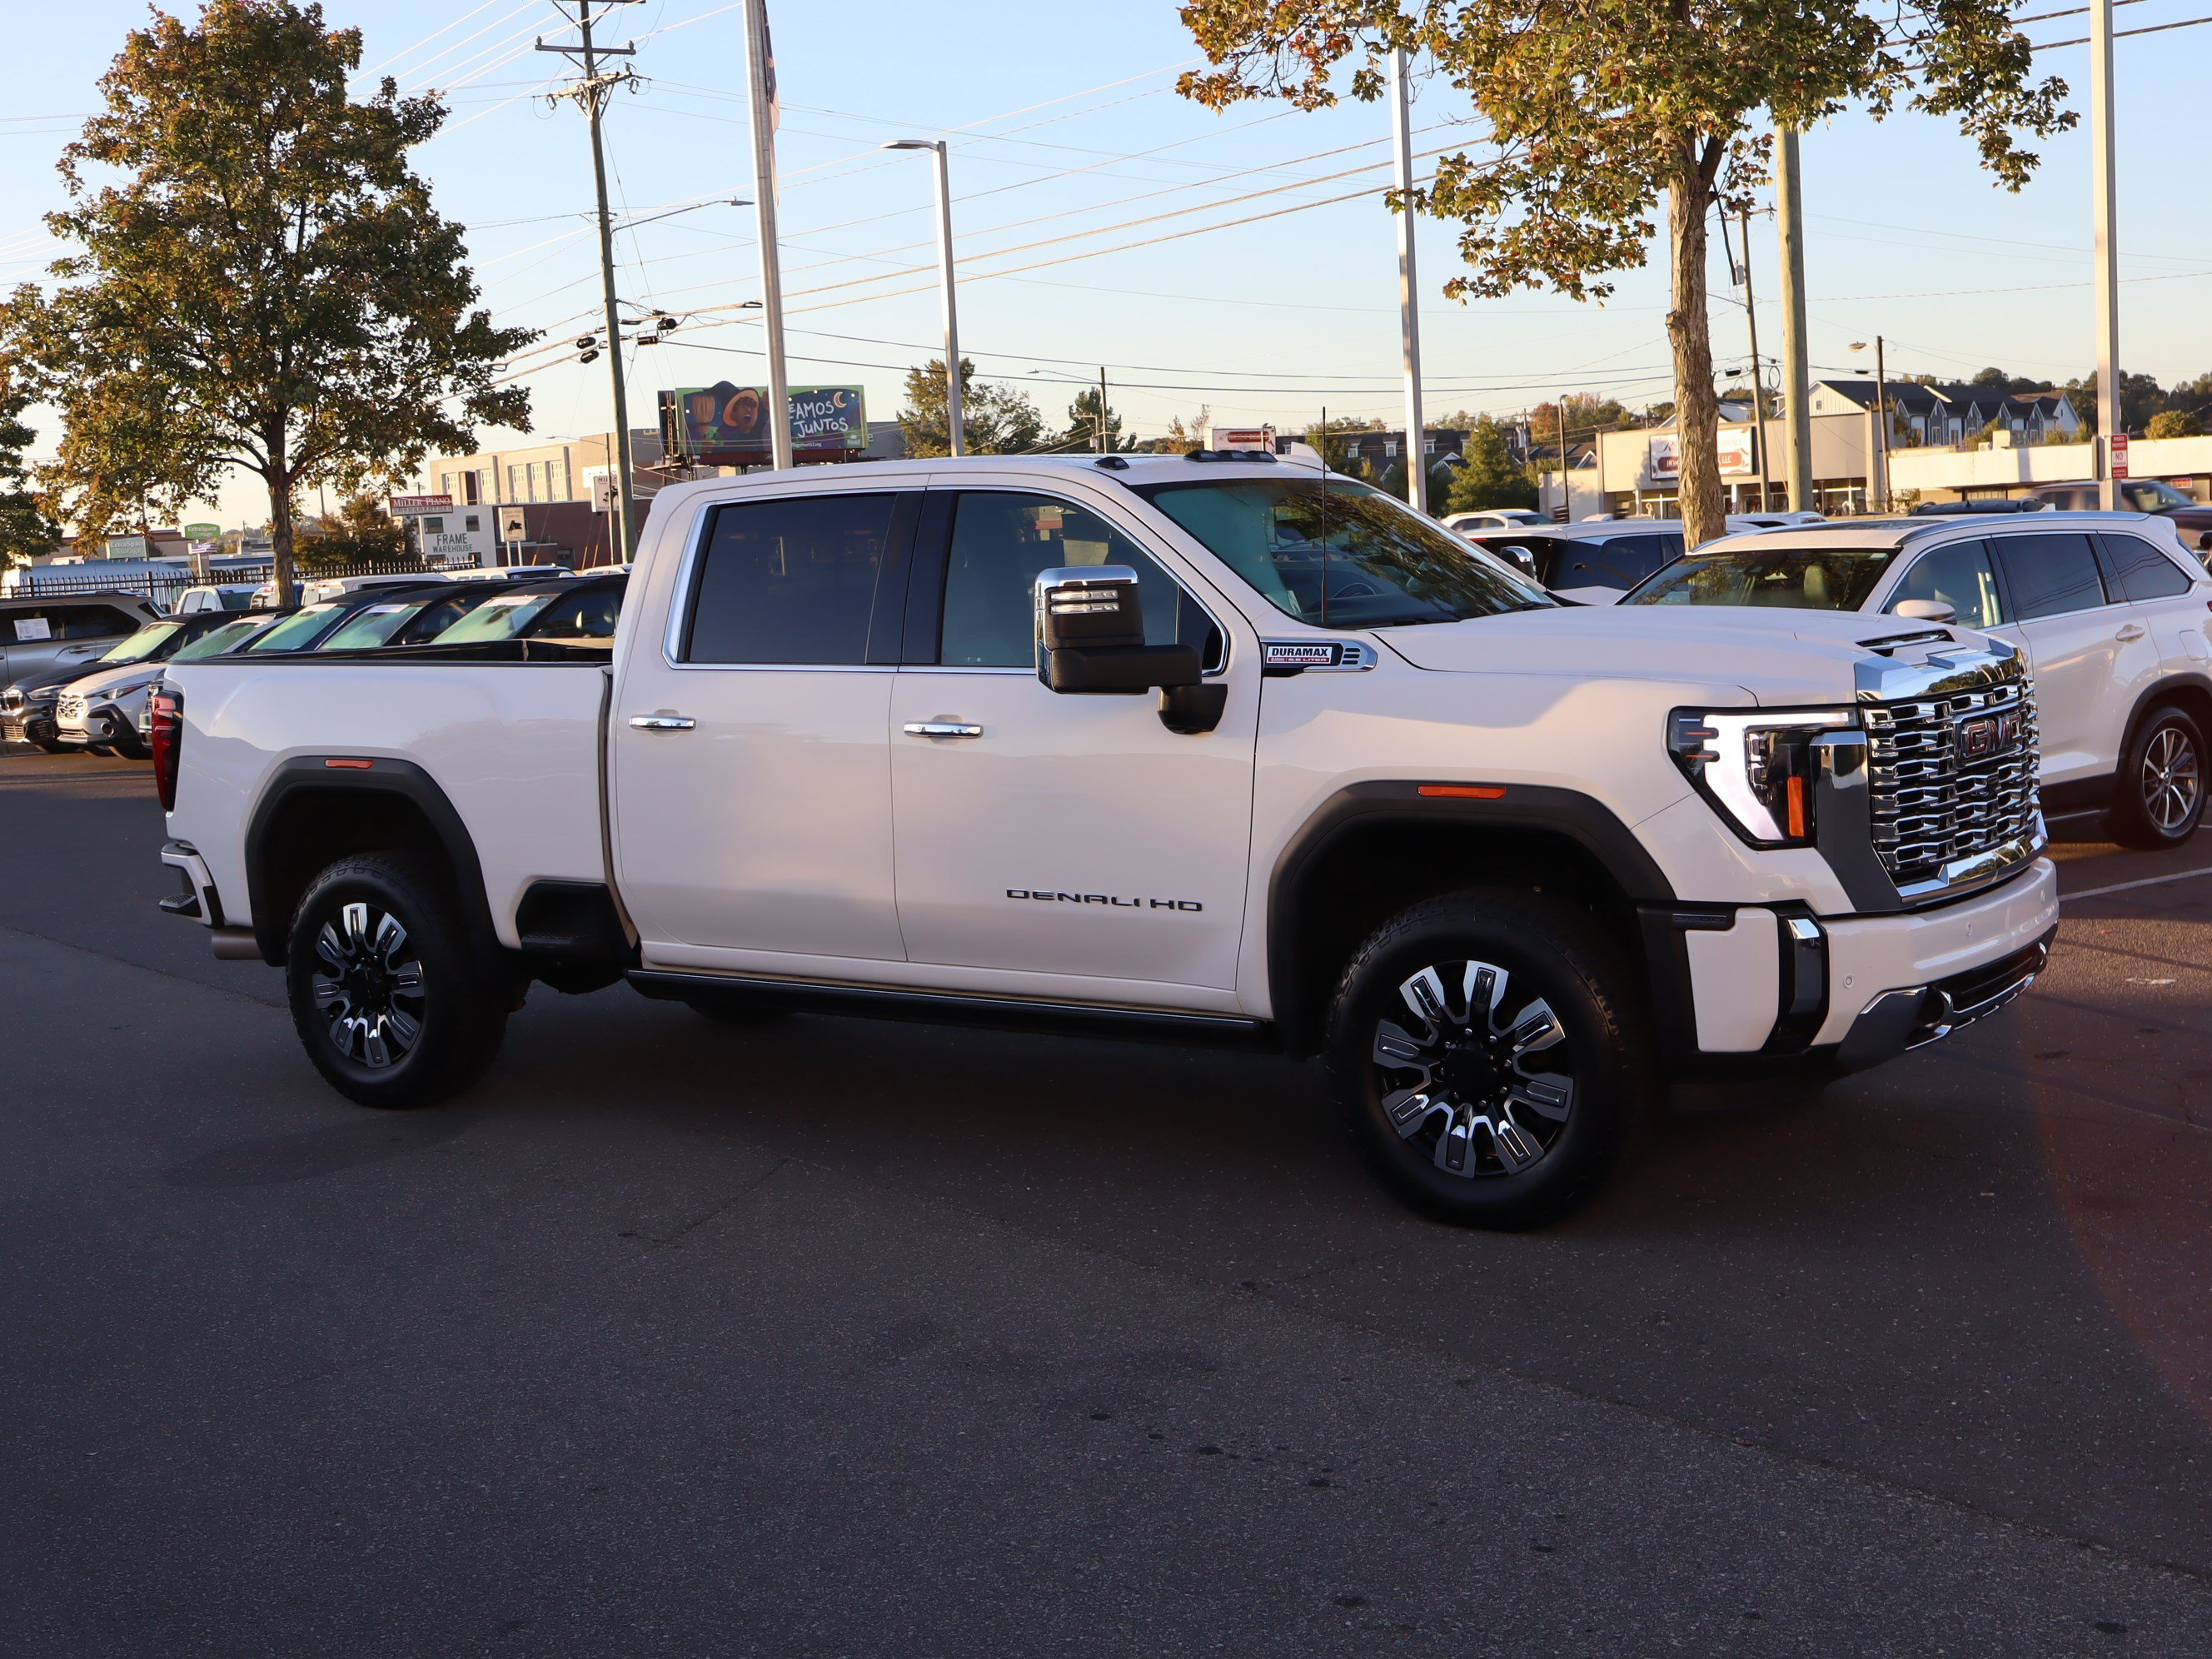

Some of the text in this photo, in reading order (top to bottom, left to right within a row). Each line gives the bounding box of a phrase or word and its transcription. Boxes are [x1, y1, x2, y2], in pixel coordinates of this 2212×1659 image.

[789, 401, 834, 420] EAMOS
[2115, 451, 2123, 461] NO
[393, 497, 450, 507] MILLER PIANO
[436, 533, 467, 546] FRAME
[432, 544, 474, 553] WAREHOUSE
[1272, 648, 1328, 656] DURAMAX
[1965, 713, 2021, 756] GMC
[1006, 888, 1203, 912] DENALI HD
